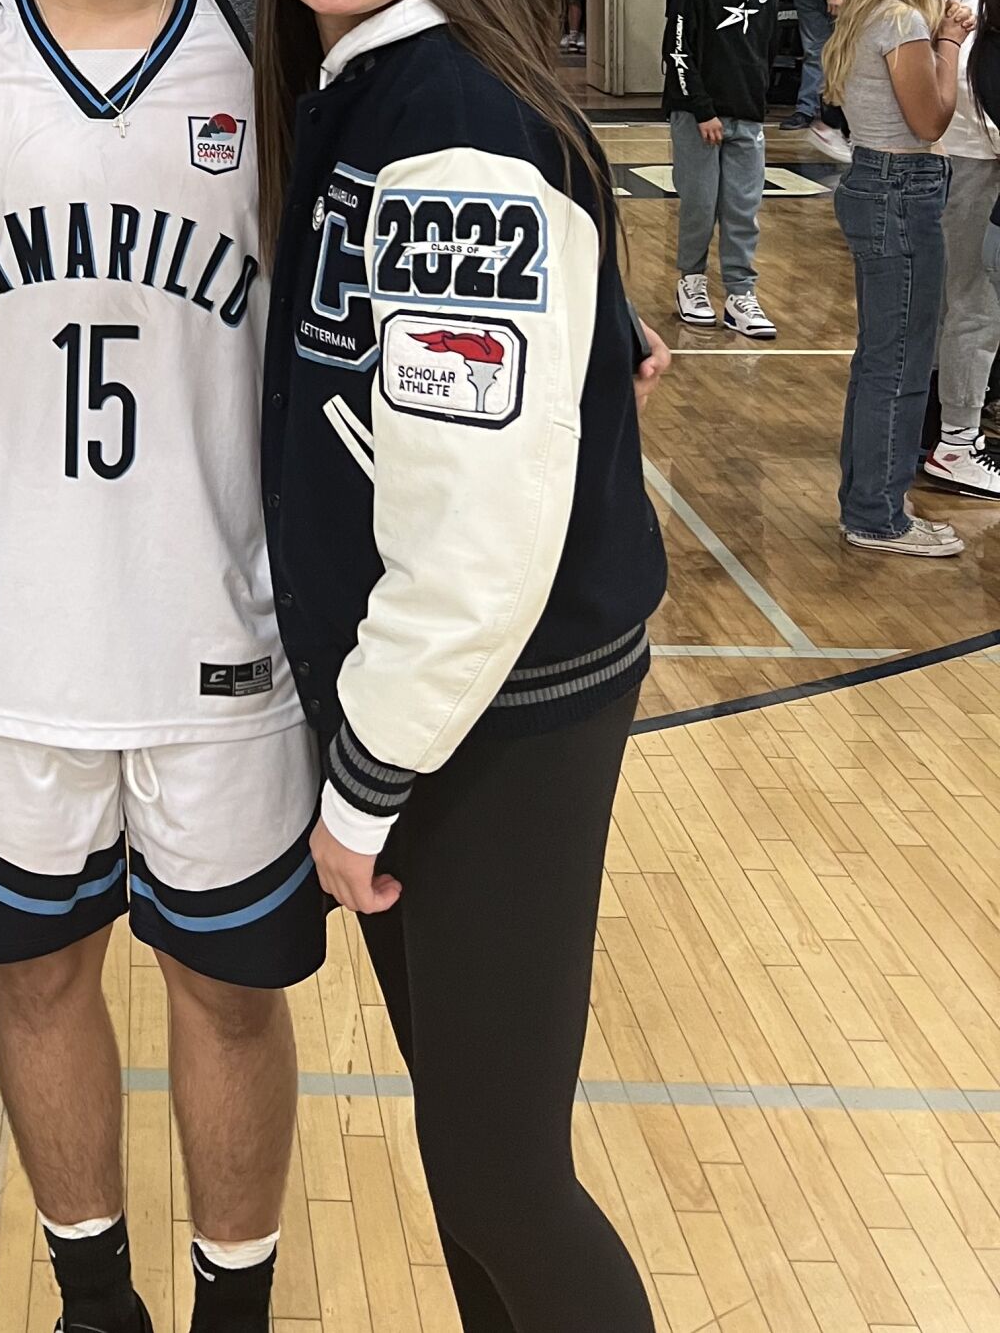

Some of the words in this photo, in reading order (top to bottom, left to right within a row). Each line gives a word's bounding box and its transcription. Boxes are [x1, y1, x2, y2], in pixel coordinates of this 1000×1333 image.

[197, 142, 235, 153] COASTAL
[197, 150, 234, 160] CANYON
[375, 196, 546, 306] 2022
[431, 243, 463, 254] CLASS
[466, 245, 479, 254] OF
[300, 320, 356, 351] LETTERMAN
[397, 365, 456, 385] SCHOLAR
[398, 378, 451, 398] ATHLETE
[52, 322, 141, 480] 15
[255, 662, 270, 676] 2X
